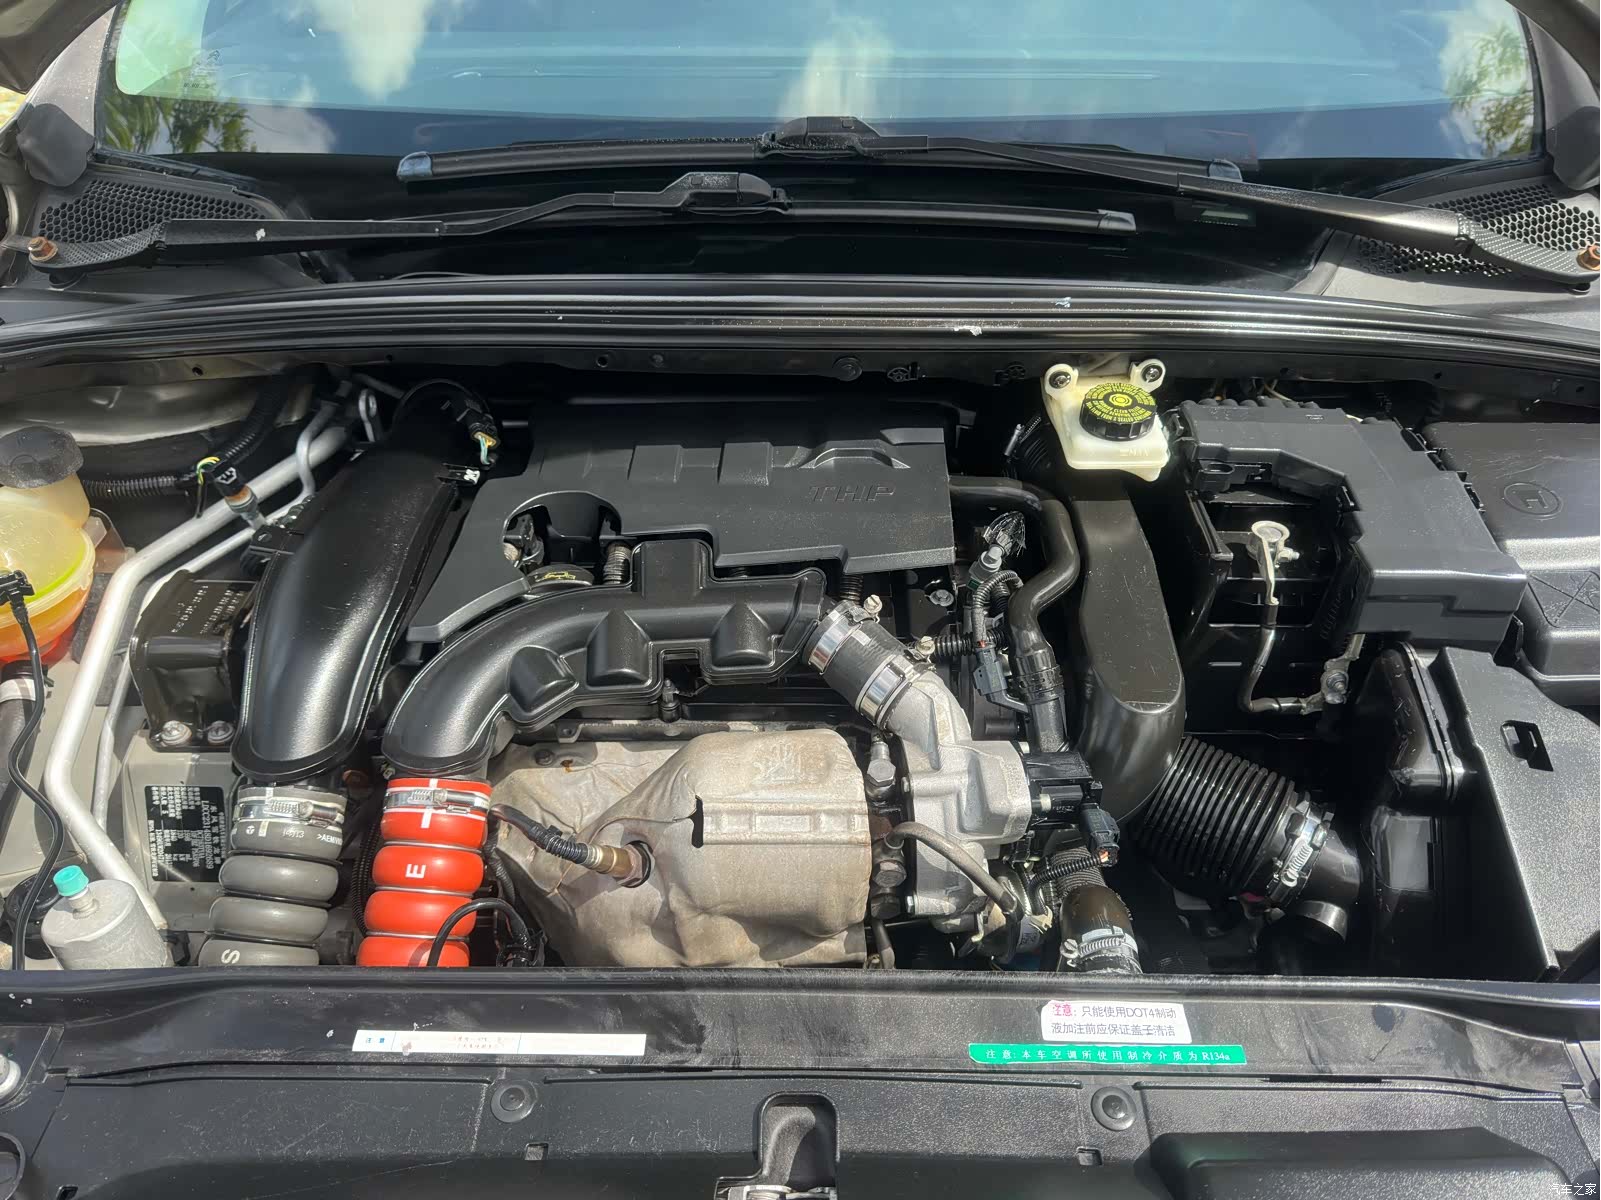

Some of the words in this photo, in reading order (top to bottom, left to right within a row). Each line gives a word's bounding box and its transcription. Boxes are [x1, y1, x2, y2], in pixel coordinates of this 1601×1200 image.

[809, 486, 896, 501] THP
[405, 864, 426, 879] E
[221, 949, 240, 964] S
[1051, 1022, 1176, 1037] 液加注前应保证盖子清洁
